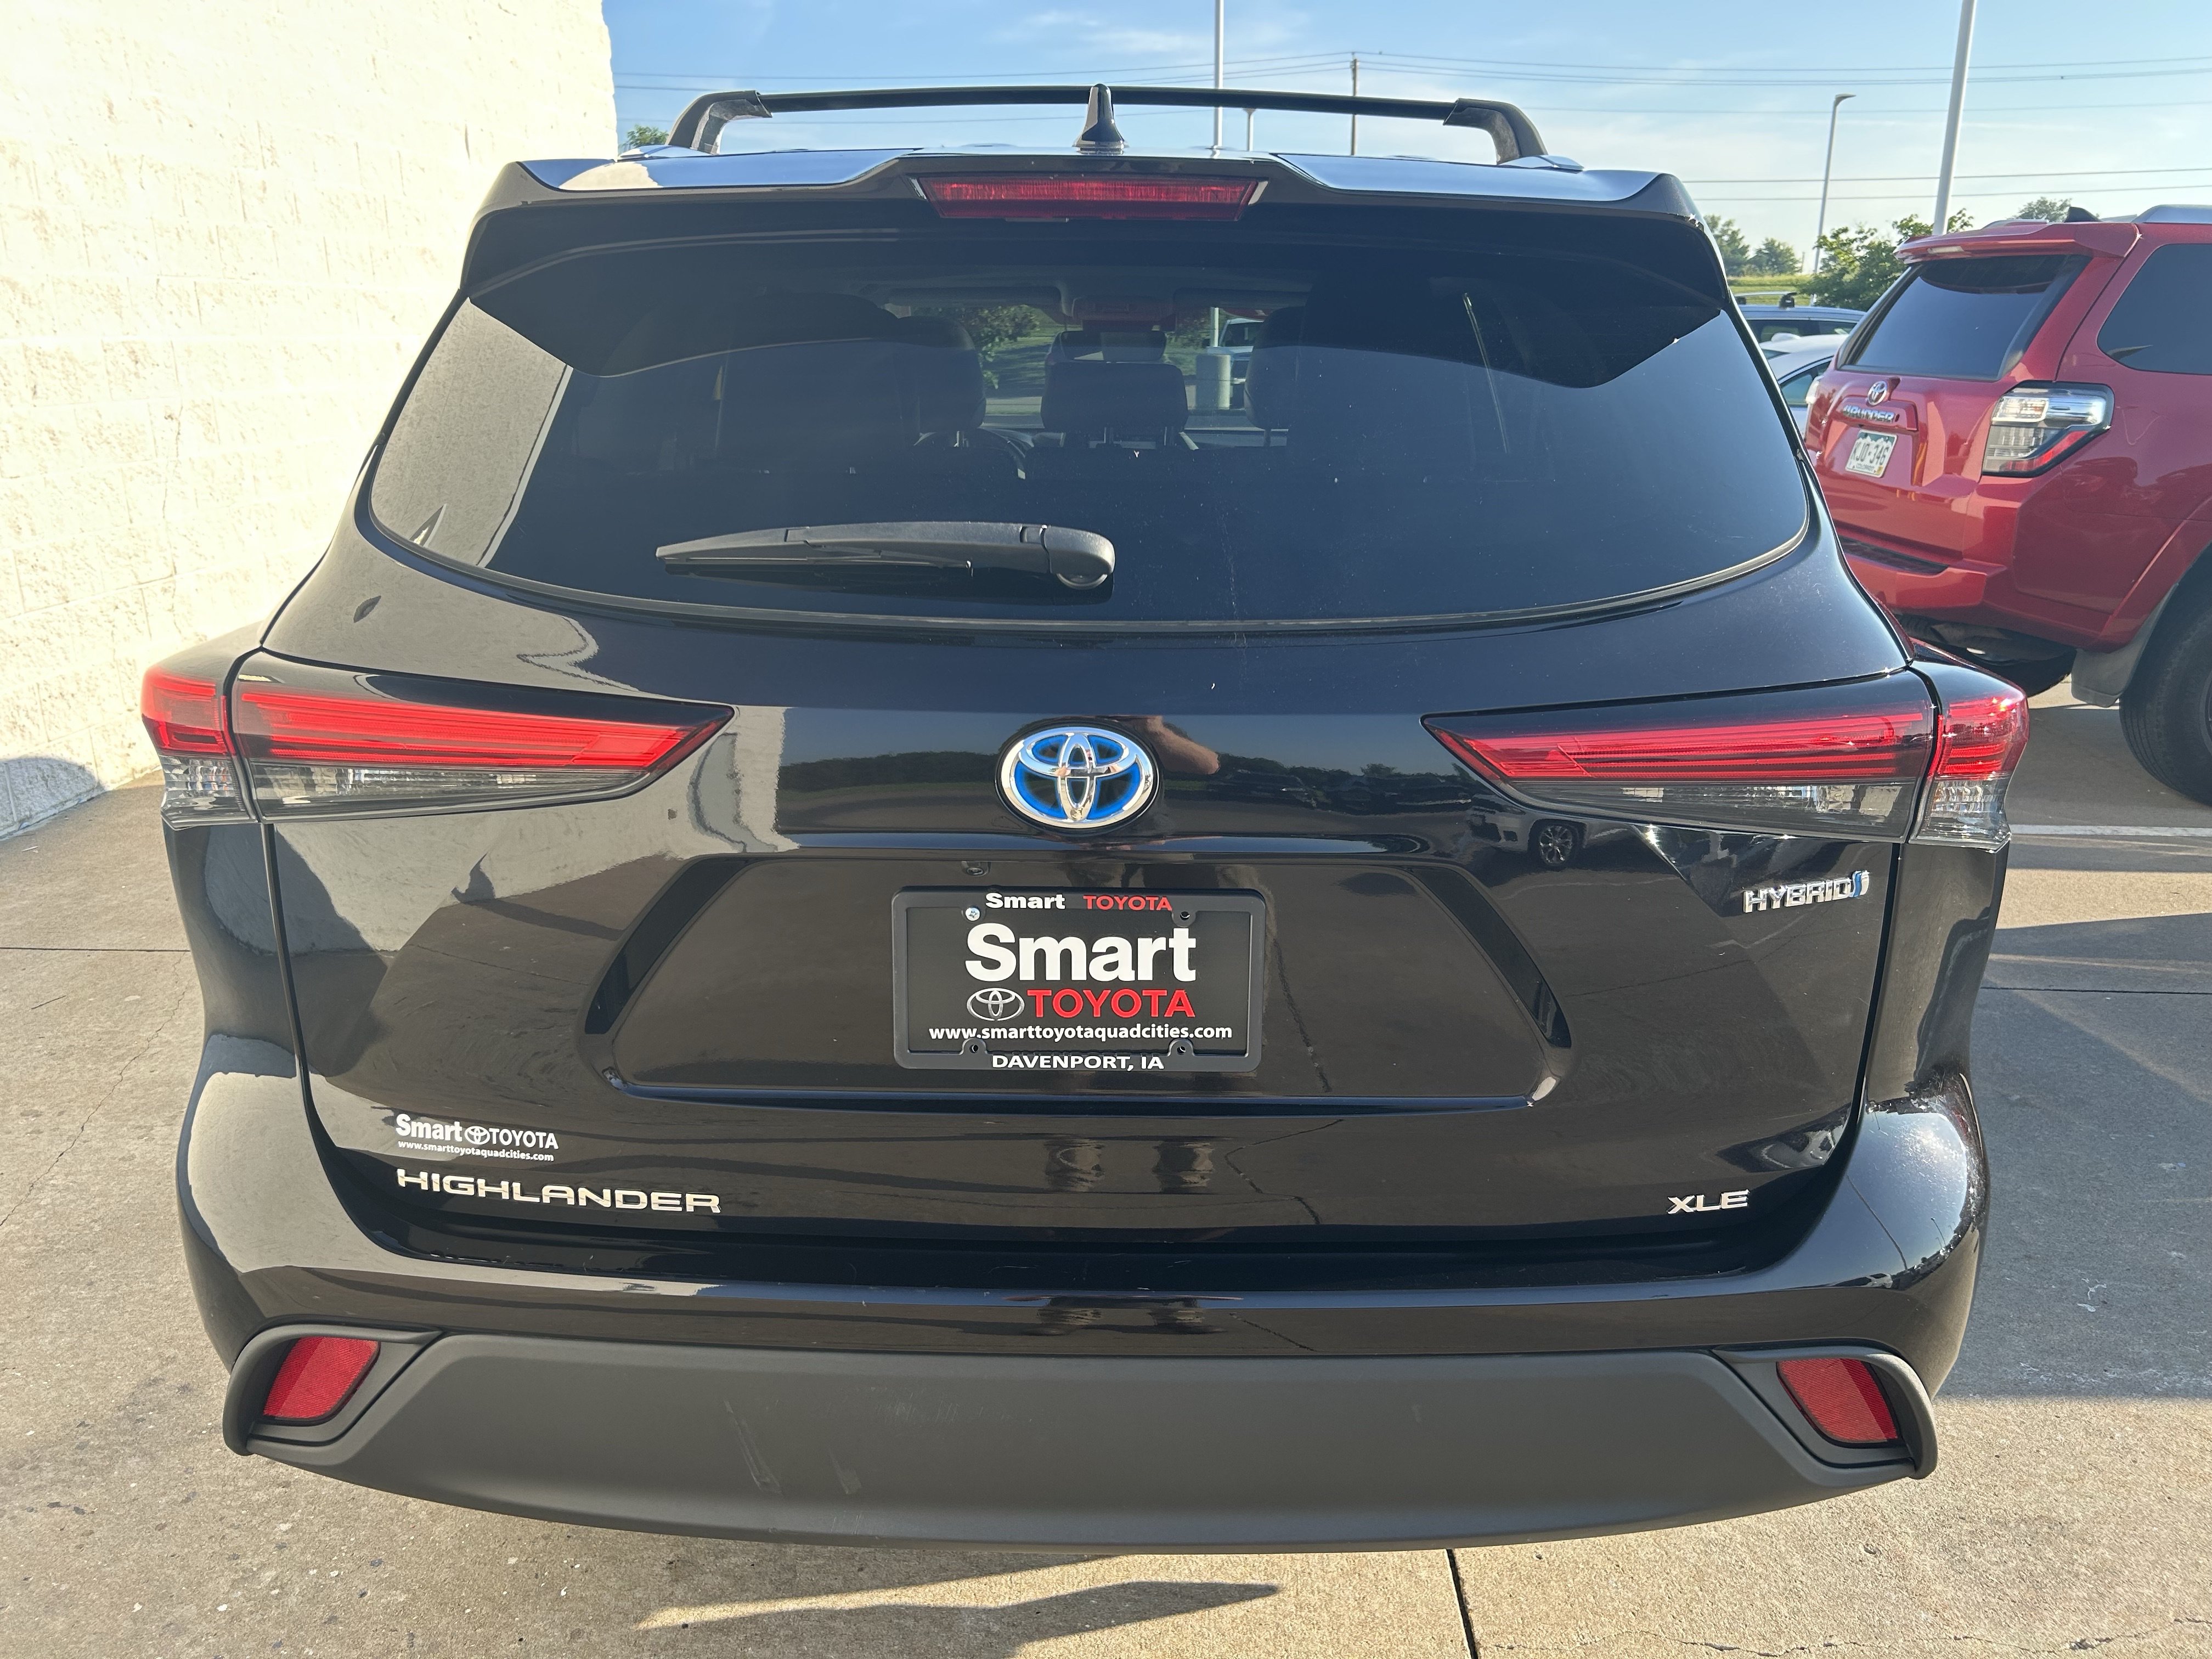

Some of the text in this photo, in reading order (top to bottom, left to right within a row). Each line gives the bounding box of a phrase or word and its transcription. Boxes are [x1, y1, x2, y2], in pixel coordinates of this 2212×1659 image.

[985, 892, 1172, 911] Smart TOYOTA
[1743, 877, 1852, 913] HYBRID
[965, 923, 1197, 982] Smart
[1027, 989, 1196, 1018] TOYOTA
[929, 1023, 1233, 1042] www.smarttoyotaquadcities.com
[992, 1055, 1165, 1071] DAVENPORT, IA
[396, 1113, 558, 1149] Smart TOYOTA
[398, 1140, 555, 1162] www.smarttoyotaquadcities.com
[397, 1169, 721, 1214] HIGHLANDER
[1667, 1189, 1750, 1215] XLE
